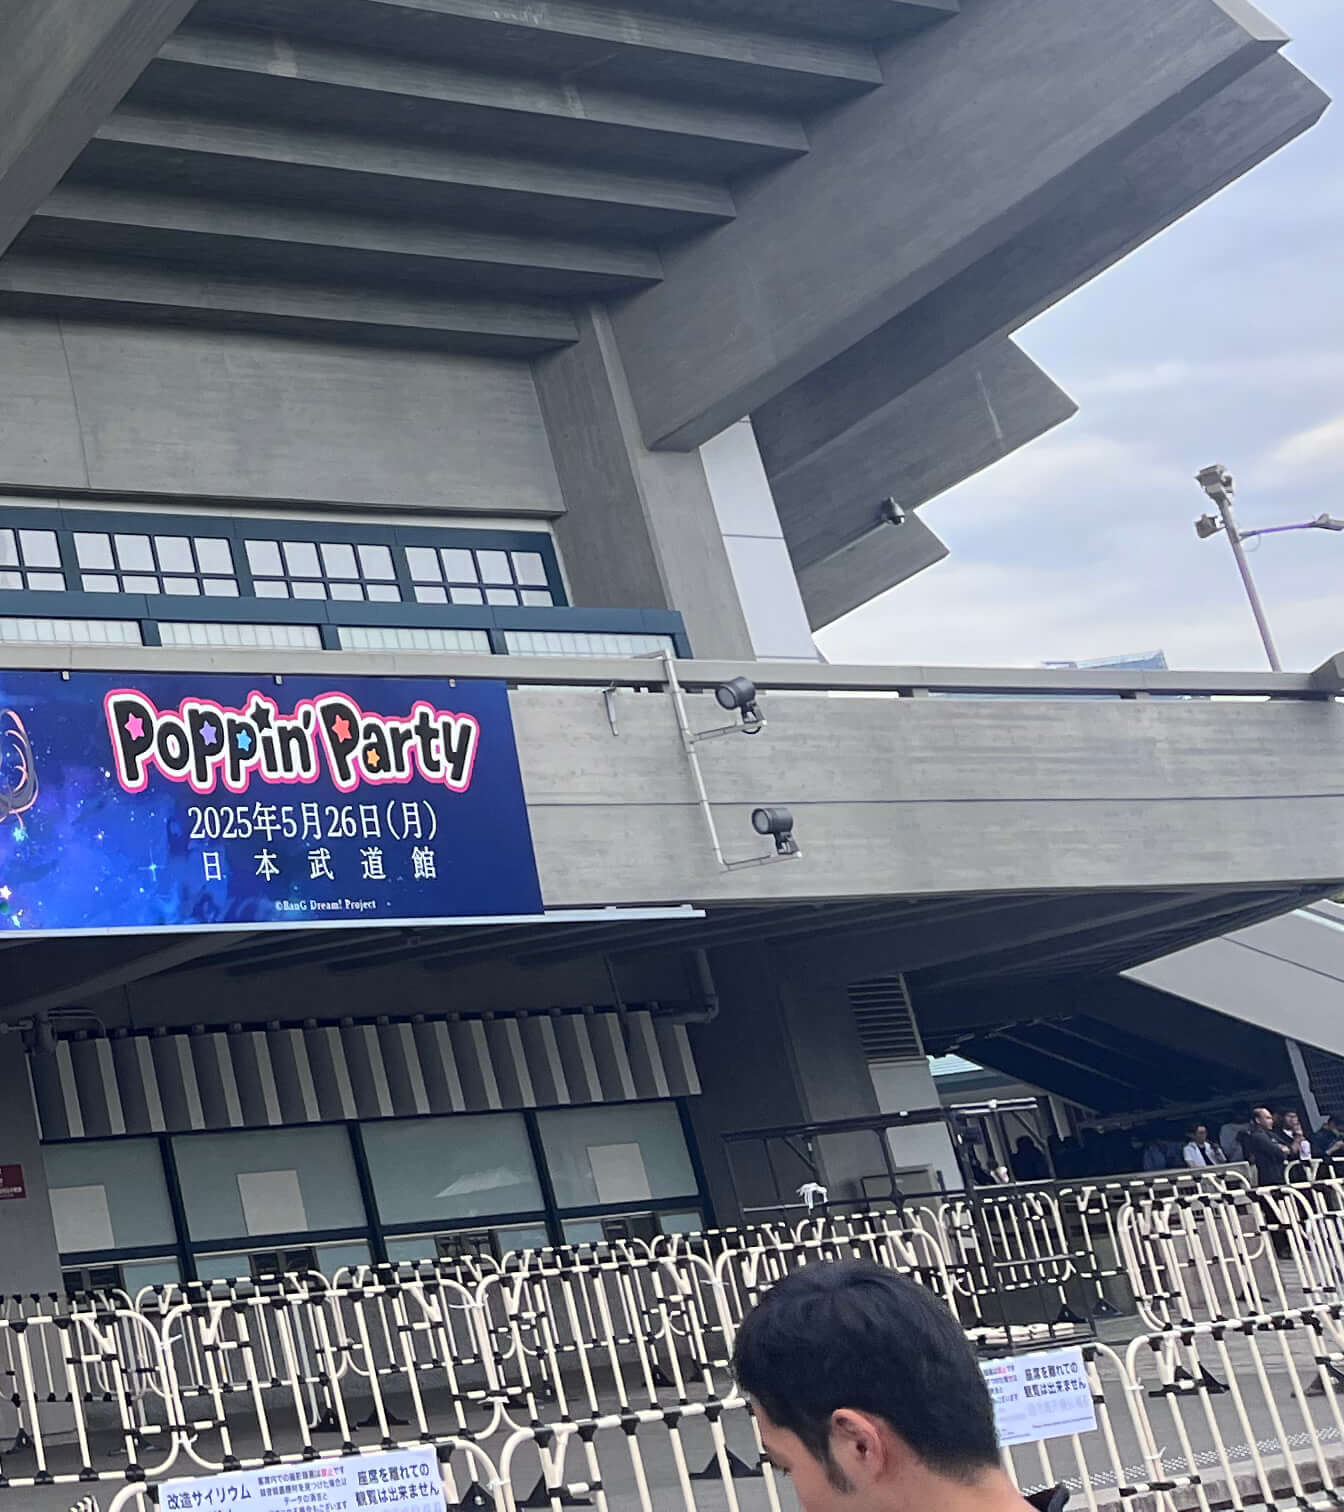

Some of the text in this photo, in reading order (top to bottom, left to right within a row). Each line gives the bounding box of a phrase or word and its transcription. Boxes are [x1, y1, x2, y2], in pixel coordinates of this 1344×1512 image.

[202, 846, 437, 882] 日本武道館
[309, 899, 343, 911] Dream!
[344, 898, 377, 911] Project
[166, 1483, 252, 1510] 改造サイリウム
